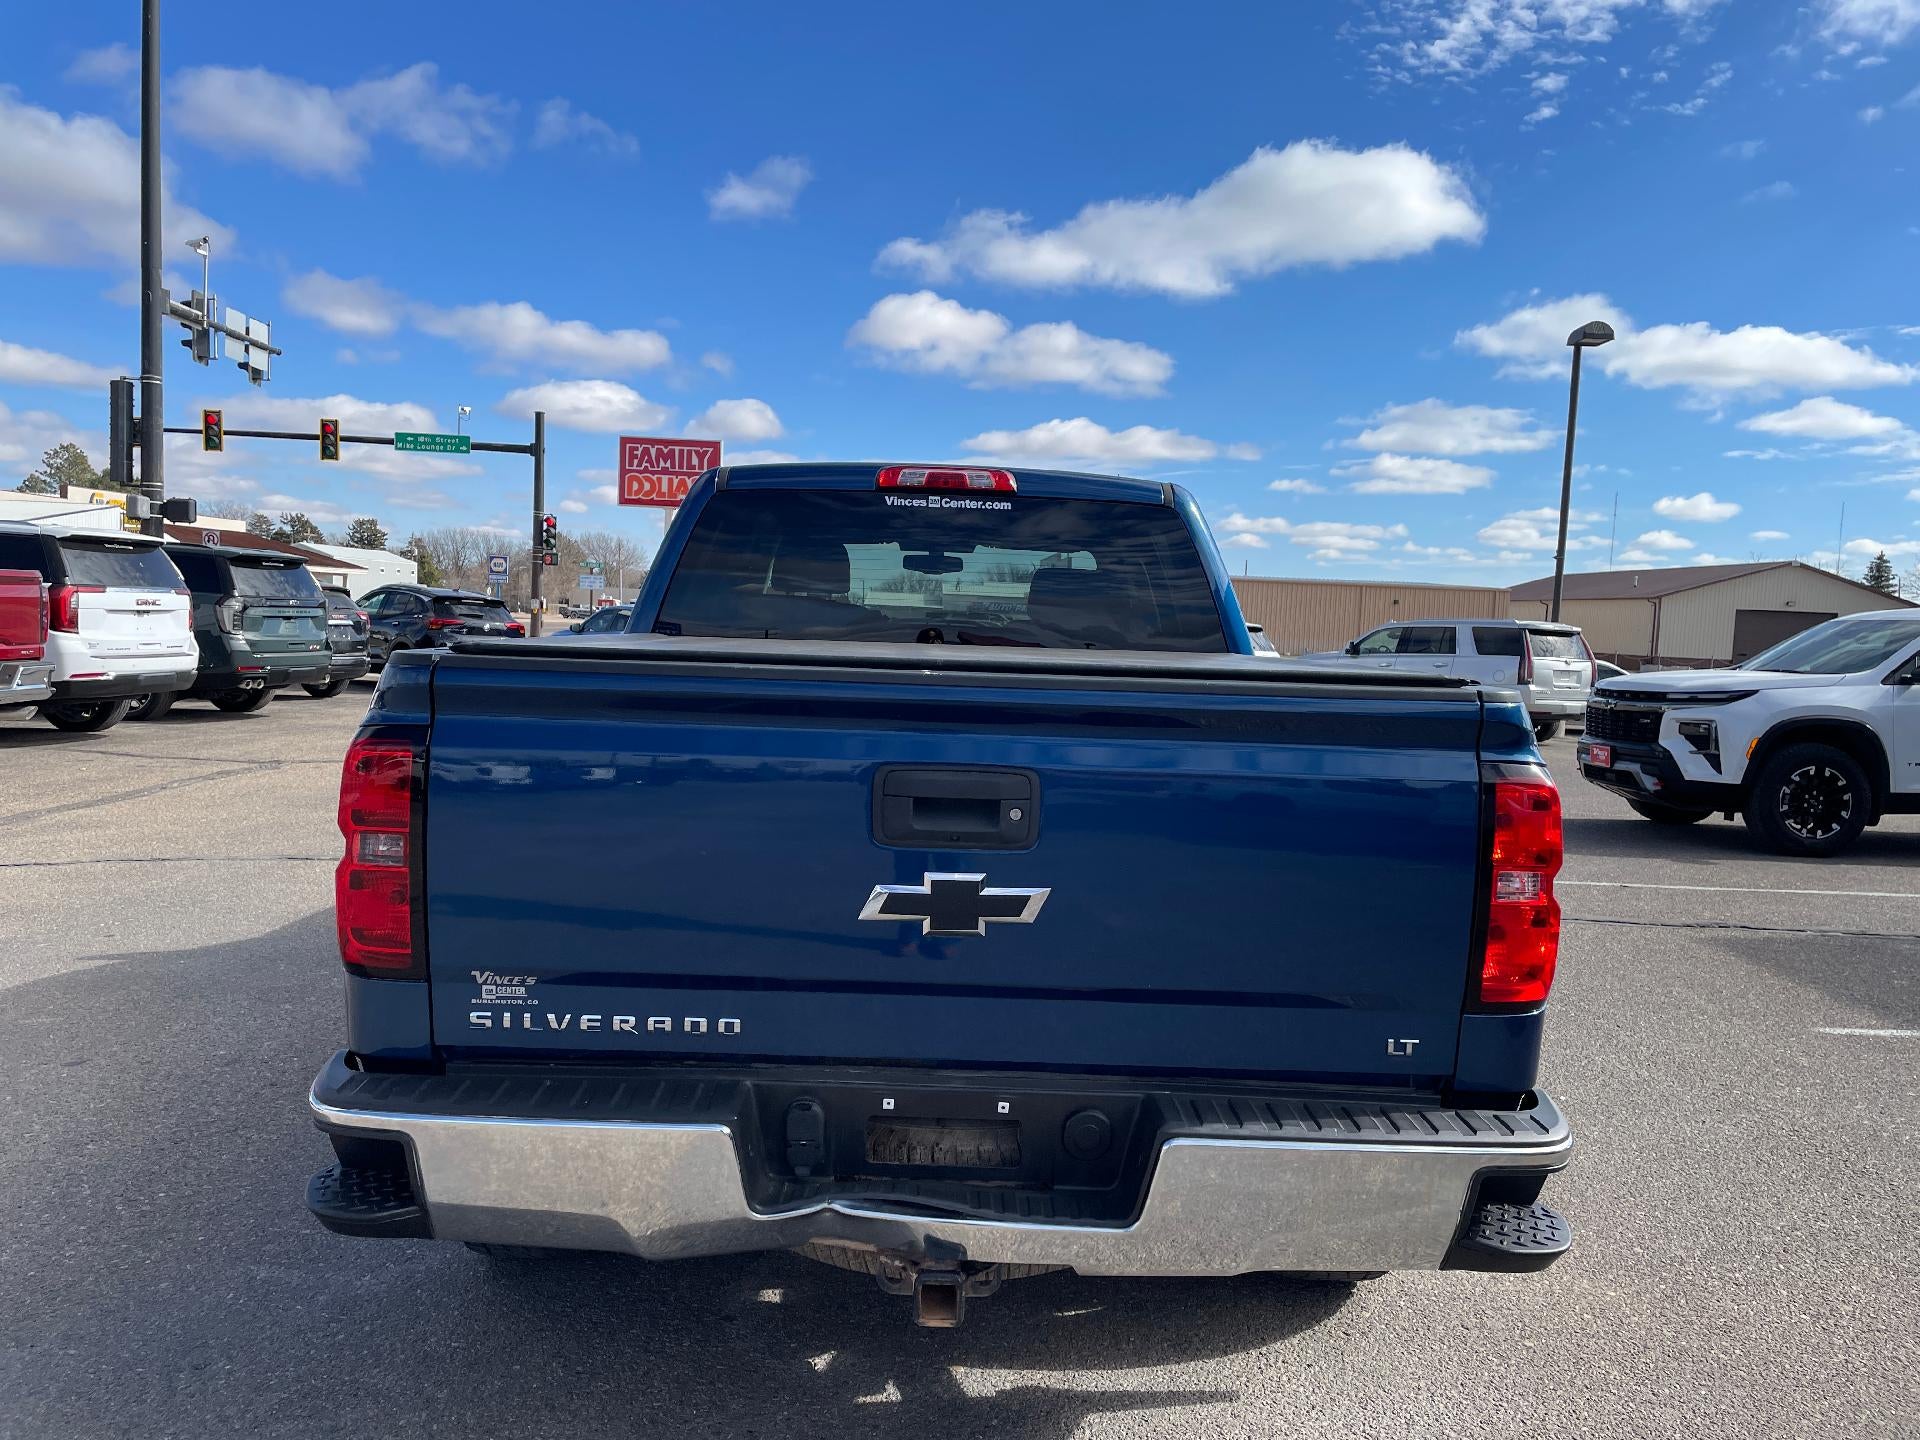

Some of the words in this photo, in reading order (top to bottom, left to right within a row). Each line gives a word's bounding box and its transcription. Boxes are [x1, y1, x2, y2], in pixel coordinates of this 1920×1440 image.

[396, 441, 414, 449] Mike
[416, 443, 444, 452] Lounge
[435, 436, 459, 444] Street
[625, 443, 714, 472] FAMILY
[624, 472, 700, 501] DOLLA
[884, 495, 927, 506] Vinces
[941, 497, 1012, 510] Center.com
[135, 598, 161, 607] GMC
[497, 986, 527, 996] CENTER
[471, 998, 526, 1006] BURLINGTON,
[469, 1011, 742, 1034] SILVERADO
[1387, 1038, 1420, 1056] LT
